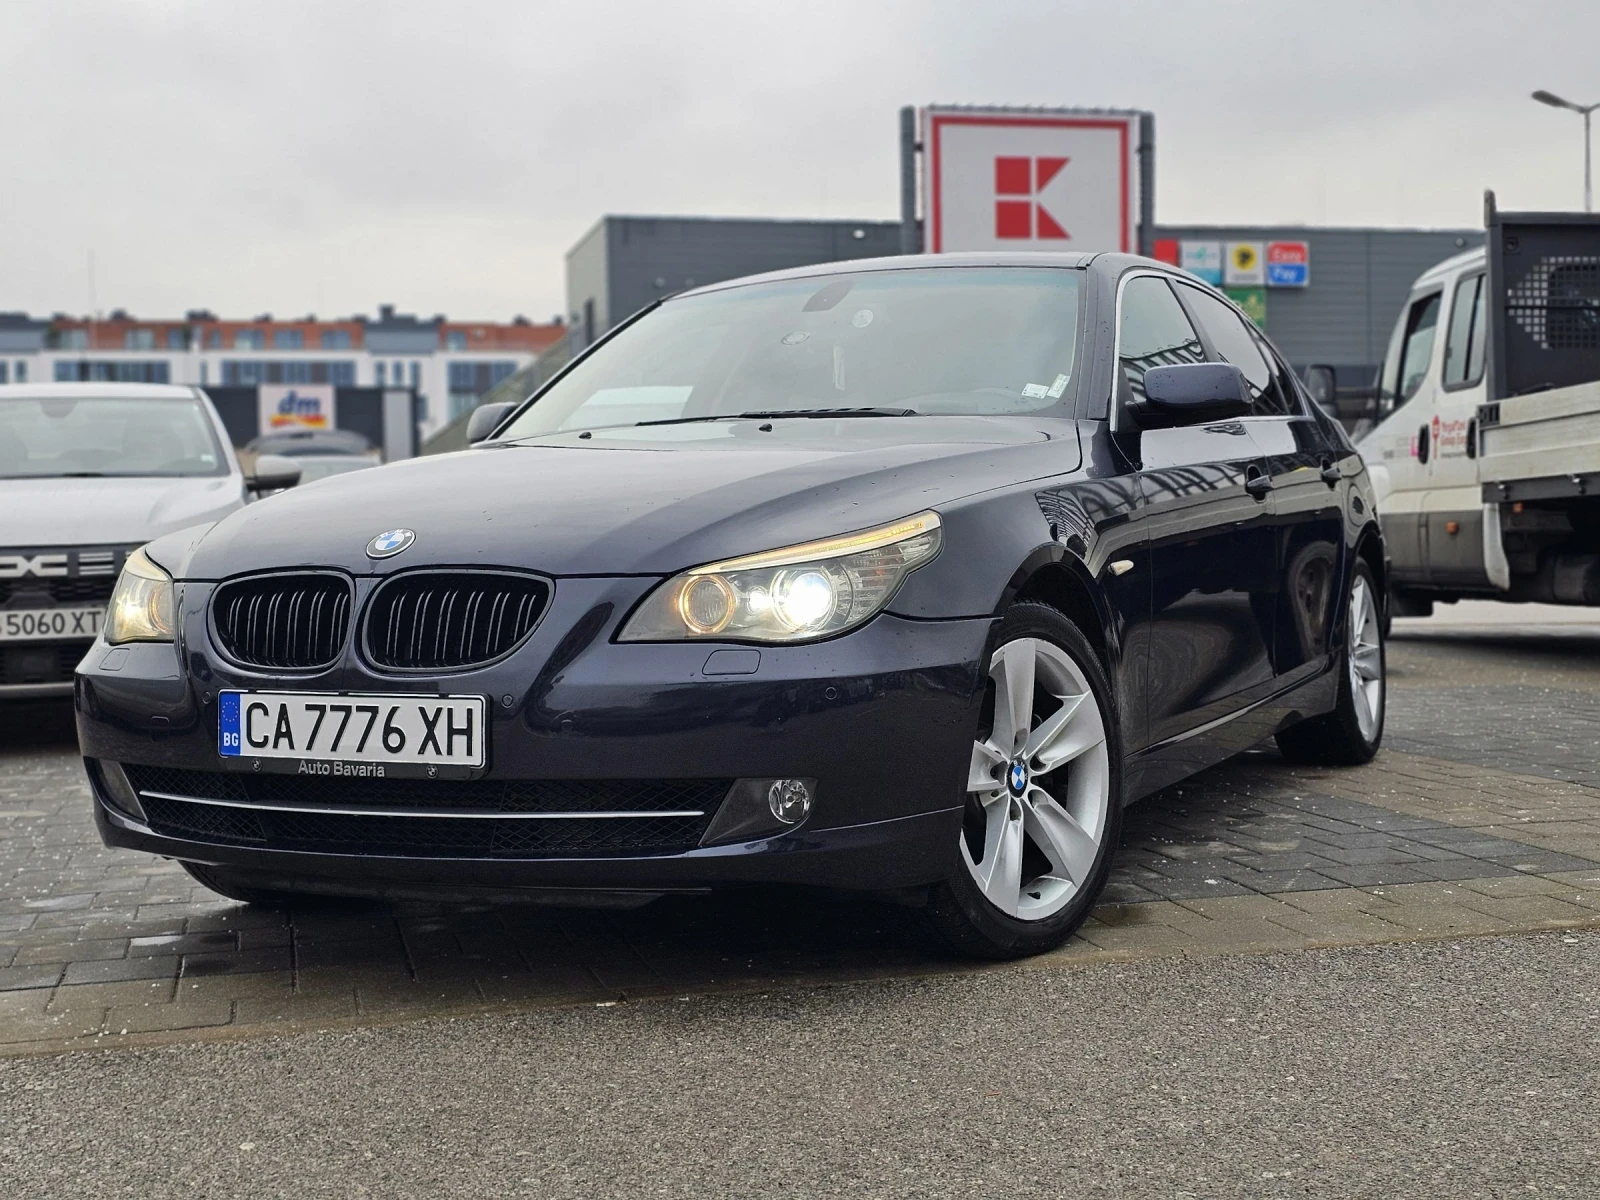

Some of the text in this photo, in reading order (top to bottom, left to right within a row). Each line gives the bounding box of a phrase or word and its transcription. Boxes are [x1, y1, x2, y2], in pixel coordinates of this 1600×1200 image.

[994, 156, 1072, 240] K
[278, 389, 321, 414] dm
[6, 611, 102, 636] 5060 XT
[223, 732, 239, 747] BG
[246, 702, 474, 757] CA 7776 XH
[298, 760, 385, 778] Auto Bavaria
